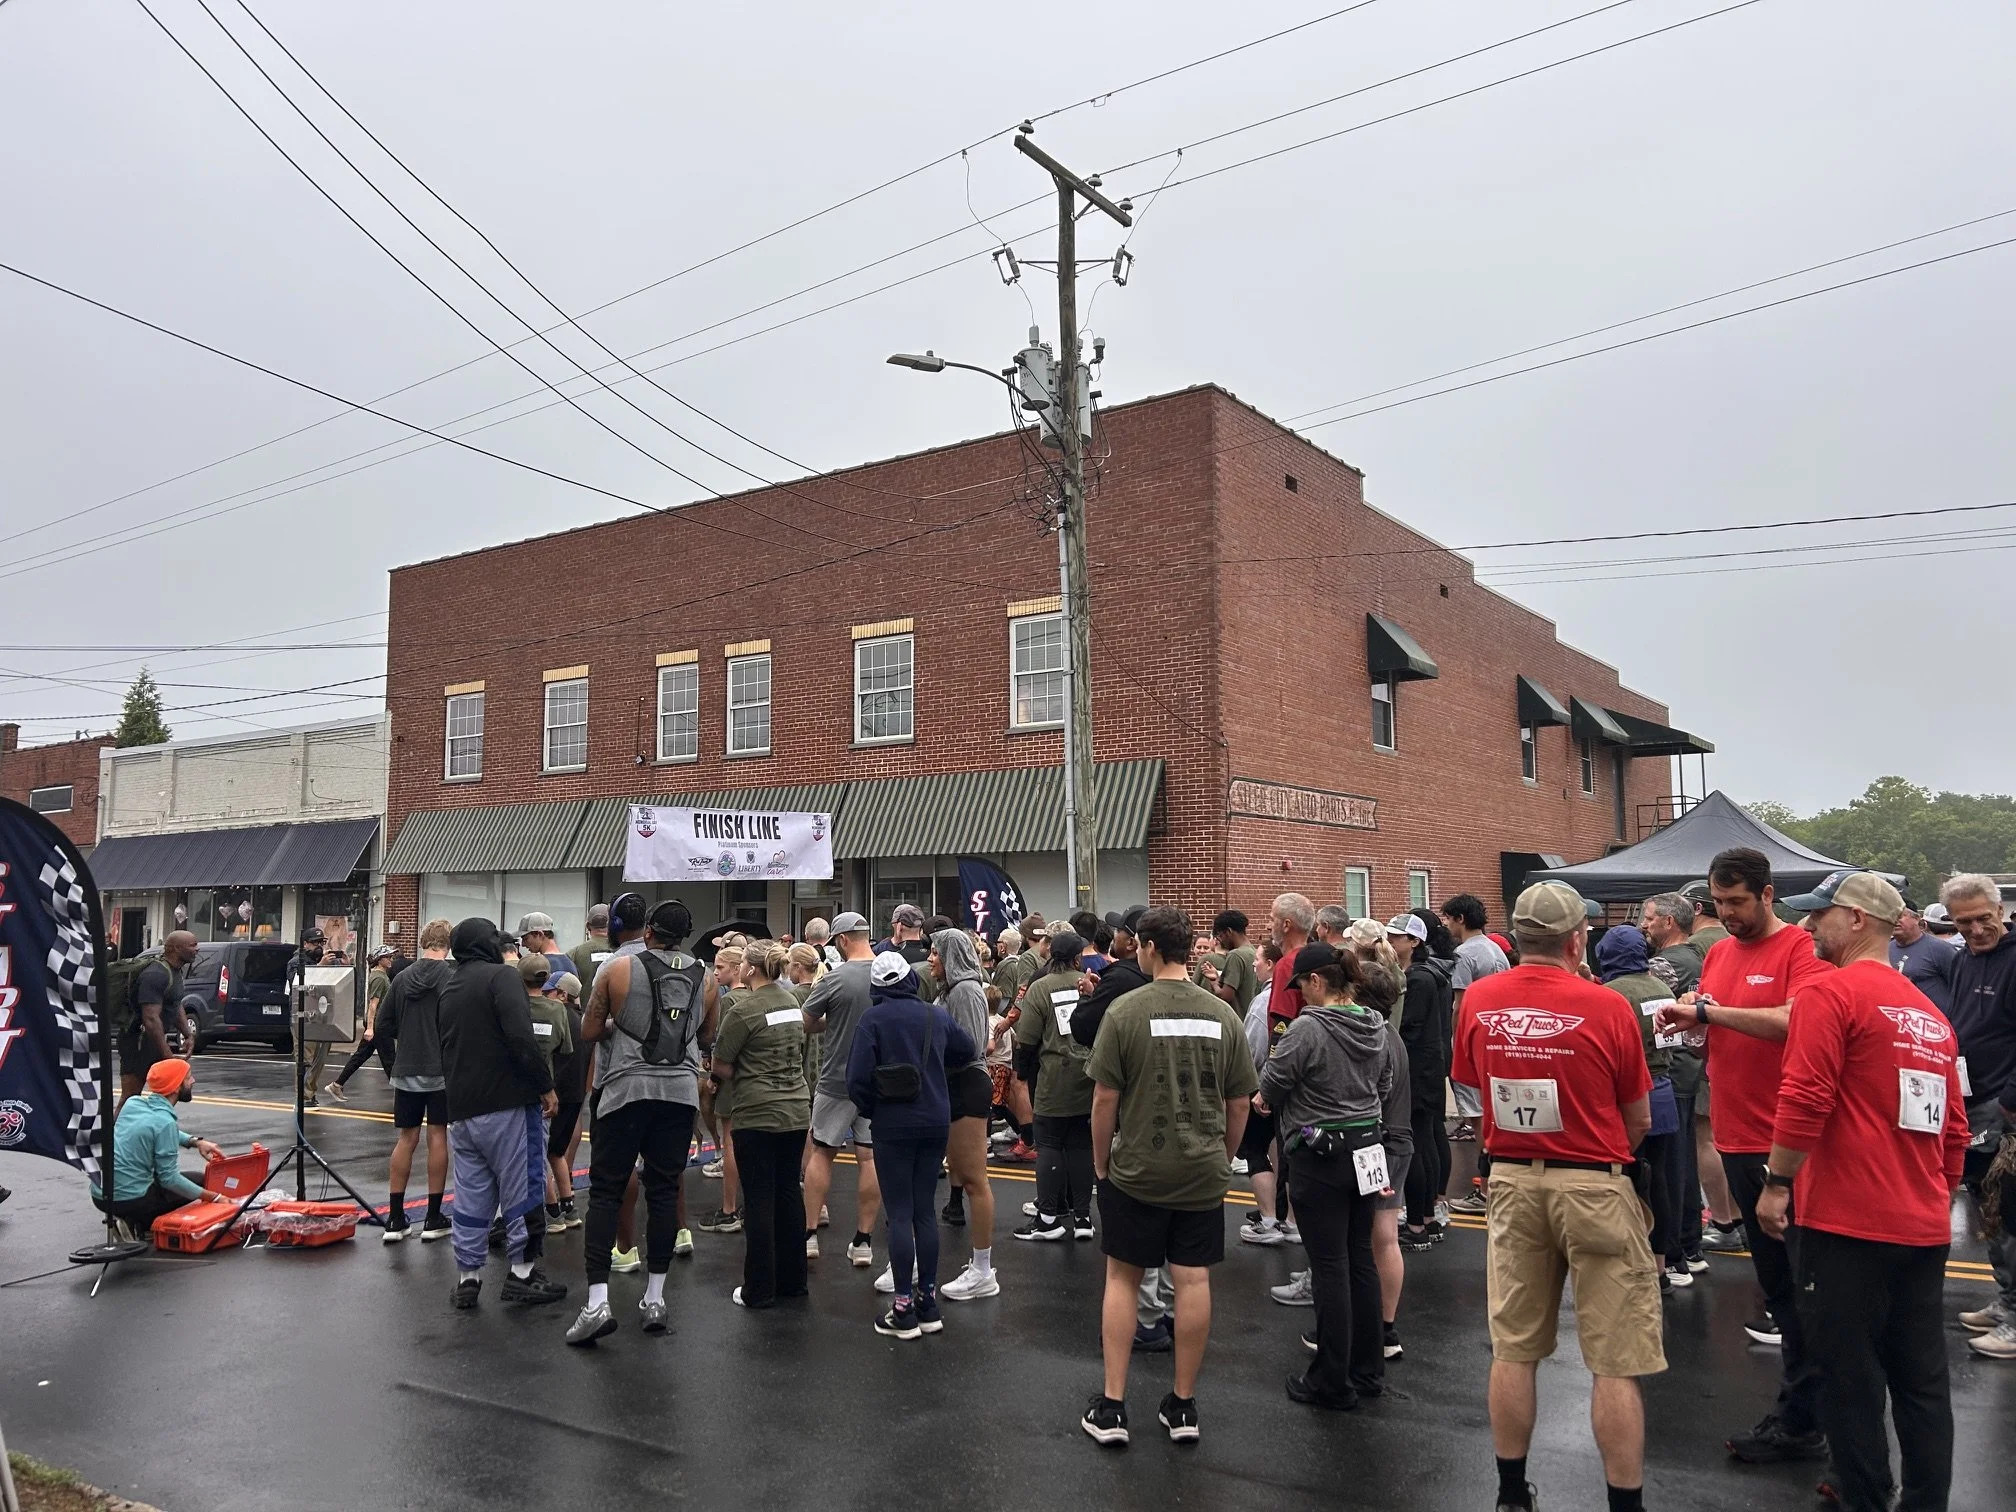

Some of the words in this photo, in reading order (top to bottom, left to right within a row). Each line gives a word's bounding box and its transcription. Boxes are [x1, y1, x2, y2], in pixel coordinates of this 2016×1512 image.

[1295, 791, 1317, 818] AUTO
[1320, 795, 1347, 822] PARTS
[693, 813, 745, 840] FINISH
[749, 815, 781, 840] LINE
[1491, 1013, 1524, 1043] Red
[1525, 1014, 1560, 1036] Truck
[1513, 1106, 1537, 1126] 17
[1924, 1102, 1940, 1126] 14
[1367, 1167, 1383, 1186] 113
